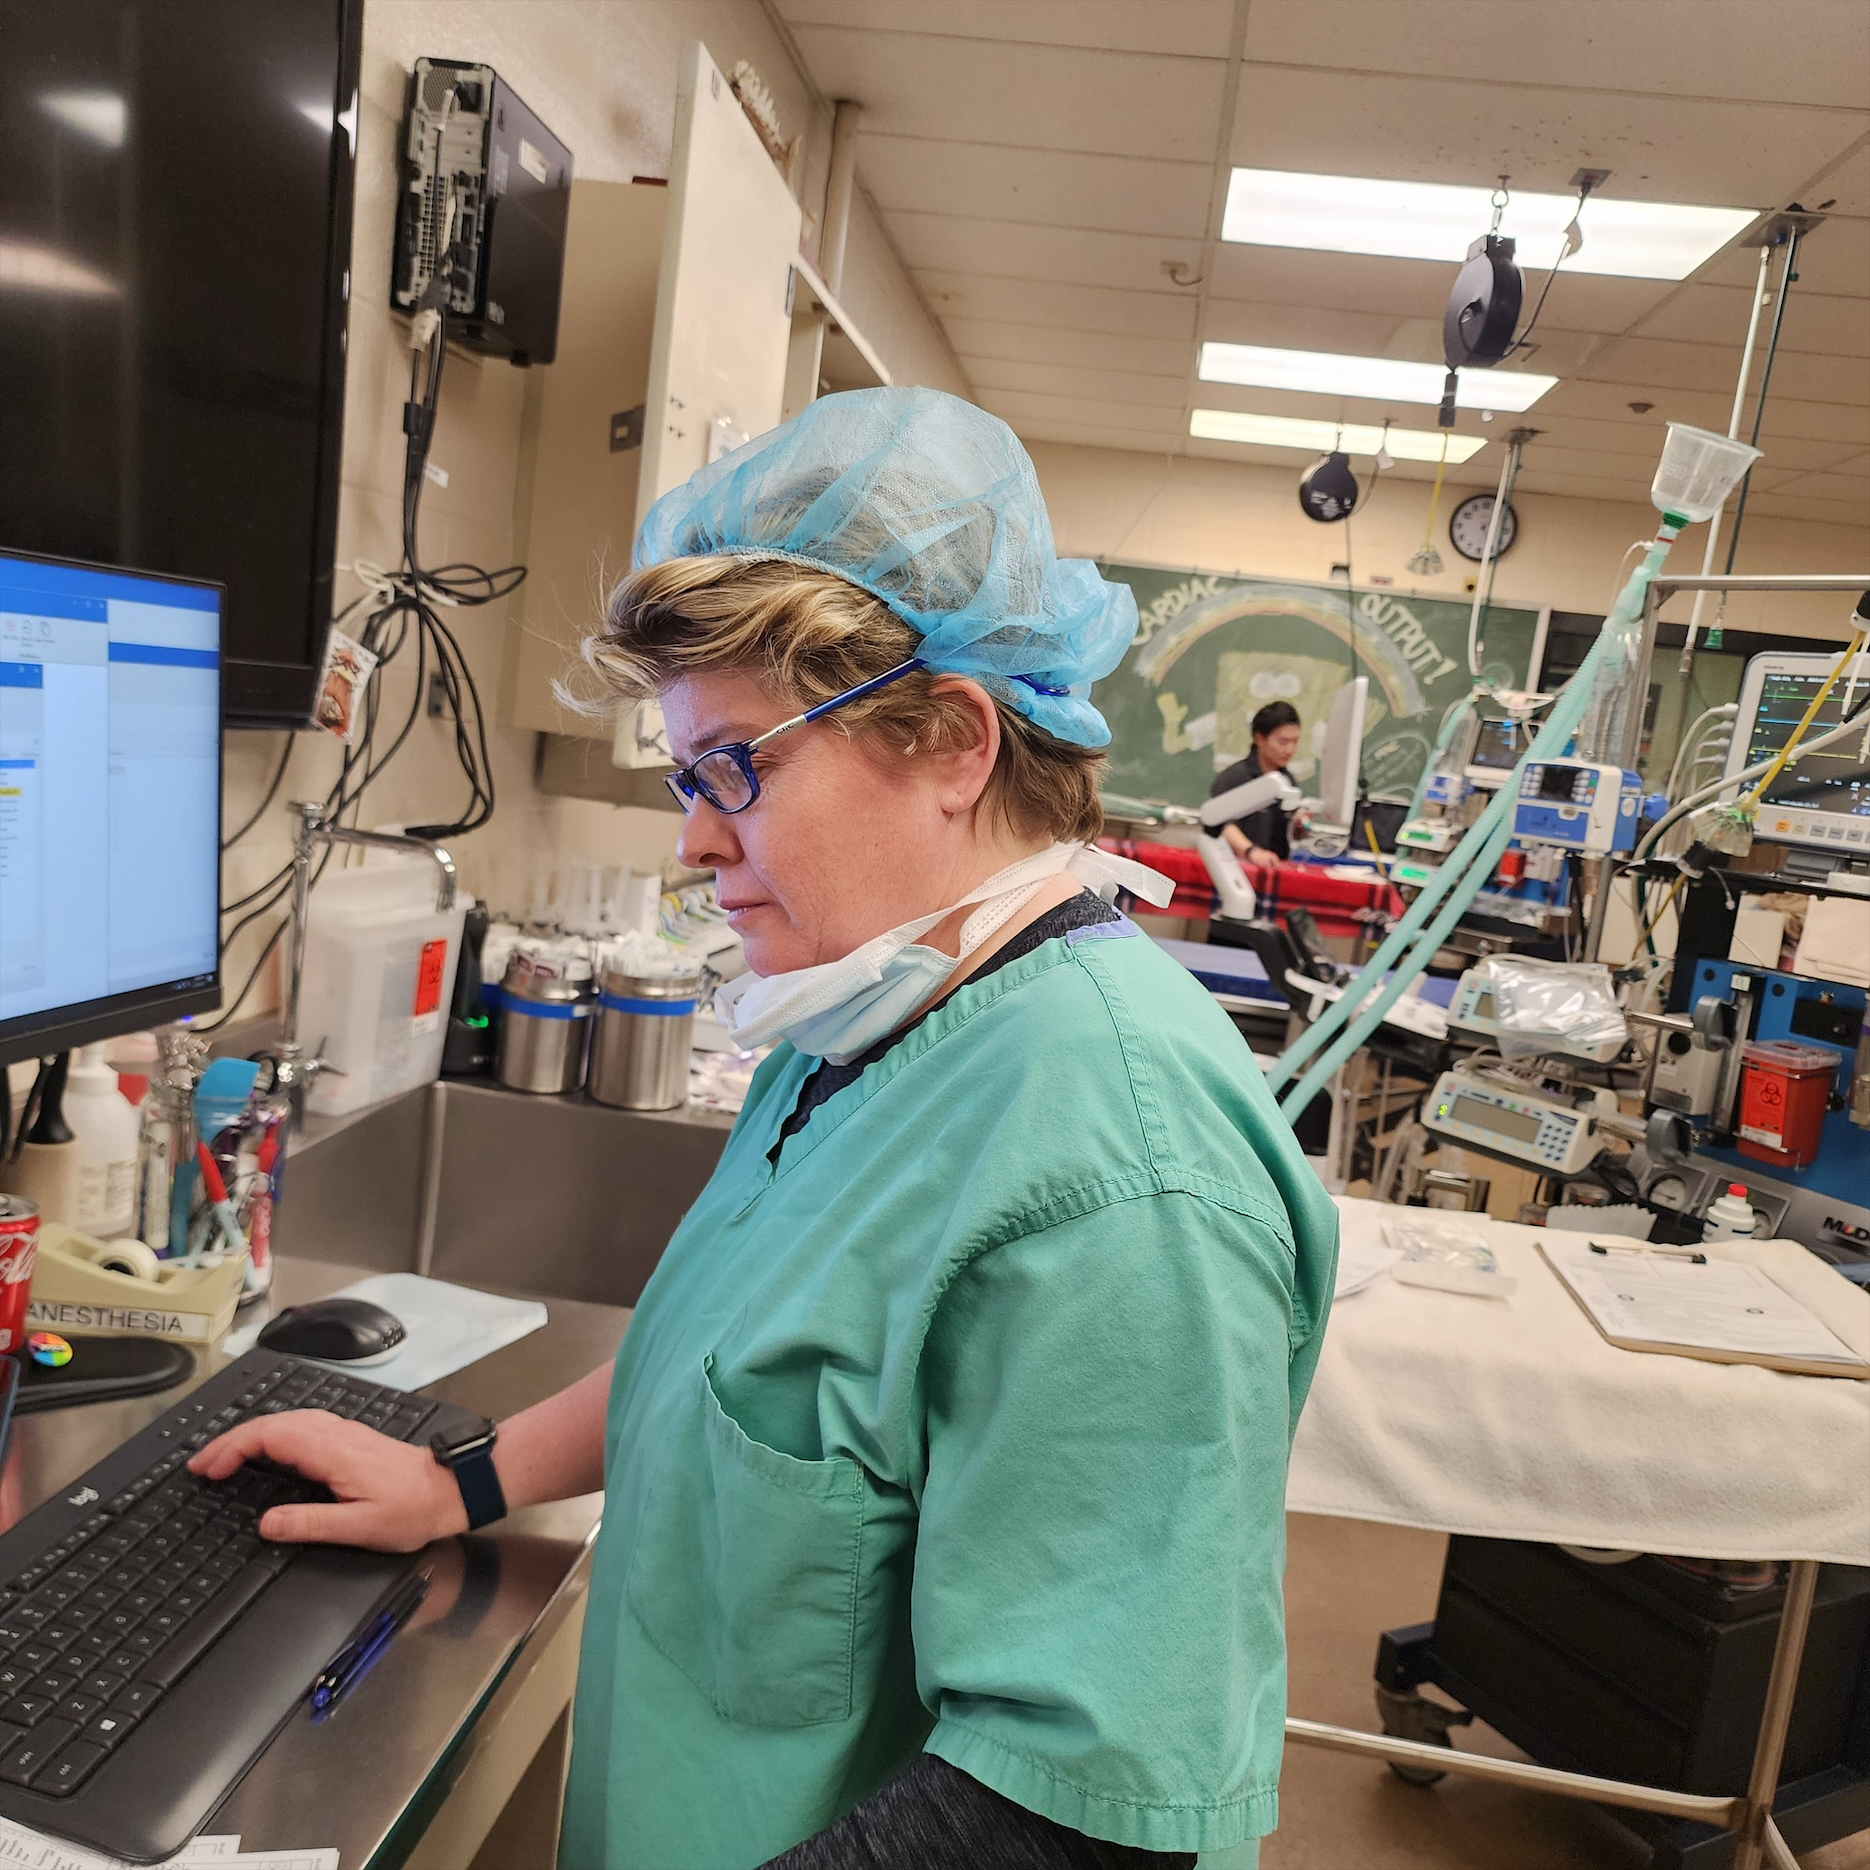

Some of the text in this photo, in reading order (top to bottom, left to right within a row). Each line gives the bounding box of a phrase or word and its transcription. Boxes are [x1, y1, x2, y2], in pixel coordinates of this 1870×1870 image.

[1131, 576, 1457, 685] CARDIAC OUTPUT!
[27, 1303, 183, 1333] ANESTHESIA
